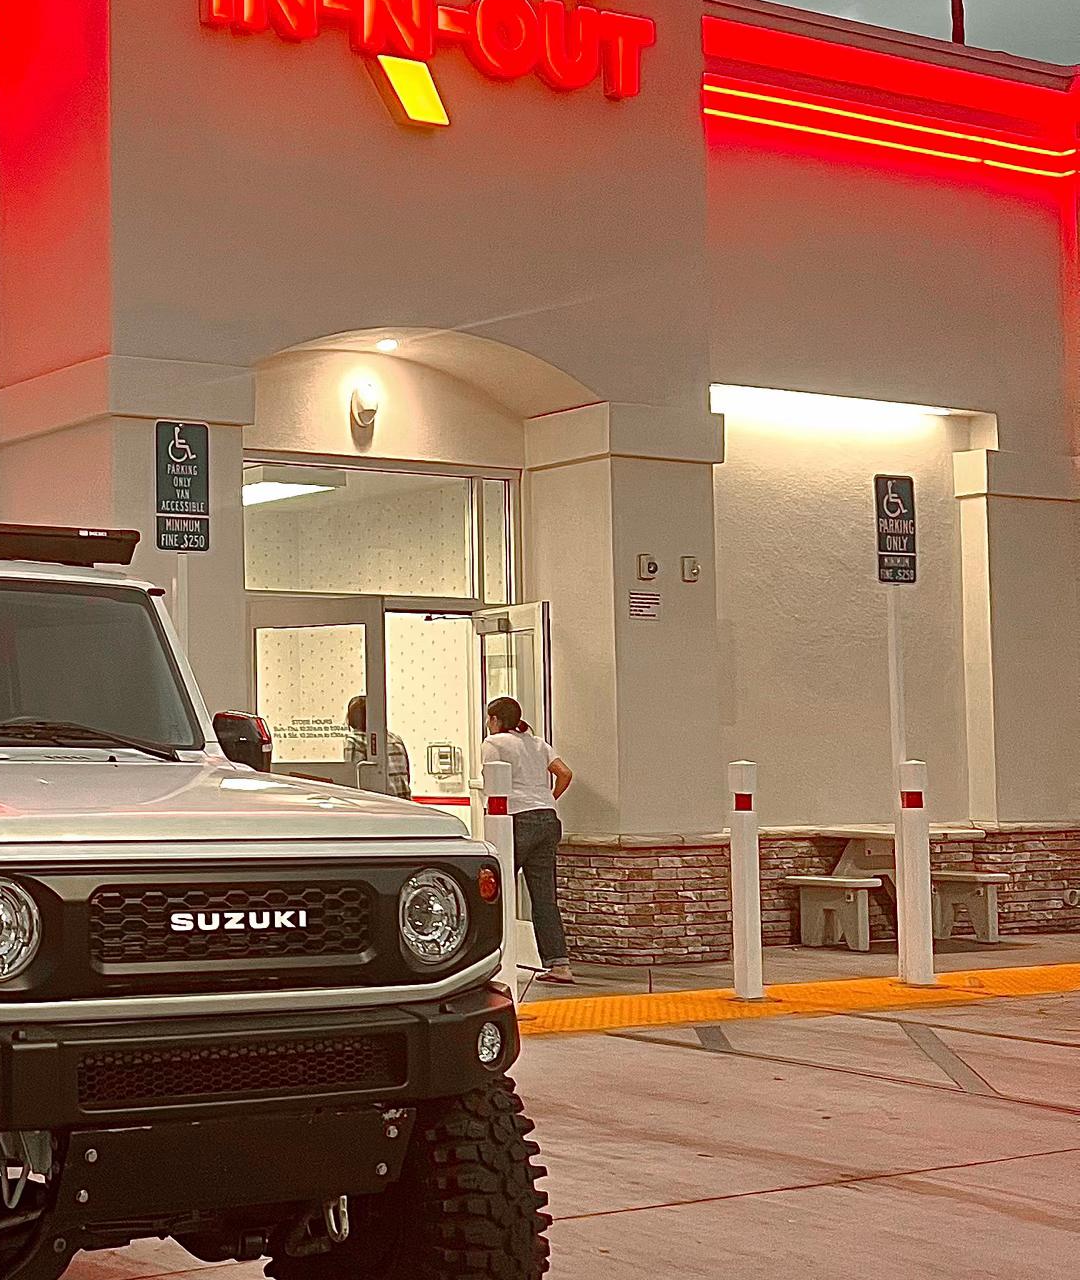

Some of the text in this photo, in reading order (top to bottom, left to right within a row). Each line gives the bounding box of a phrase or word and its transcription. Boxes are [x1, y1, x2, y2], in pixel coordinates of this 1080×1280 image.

[167, 464, 198, 476] PARKING
[173, 476, 192, 487] ONLY
[176, 489, 190, 499] VAN
[161, 500, 205, 513] ACCESSIBLE
[165, 519, 200, 532] MINIMUM
[879, 518, 914, 535] PARKING
[161, 533, 205, 548] FINE $250
[886, 535, 908, 551] ONLY
[170, 910, 307, 931] SUZUKI
